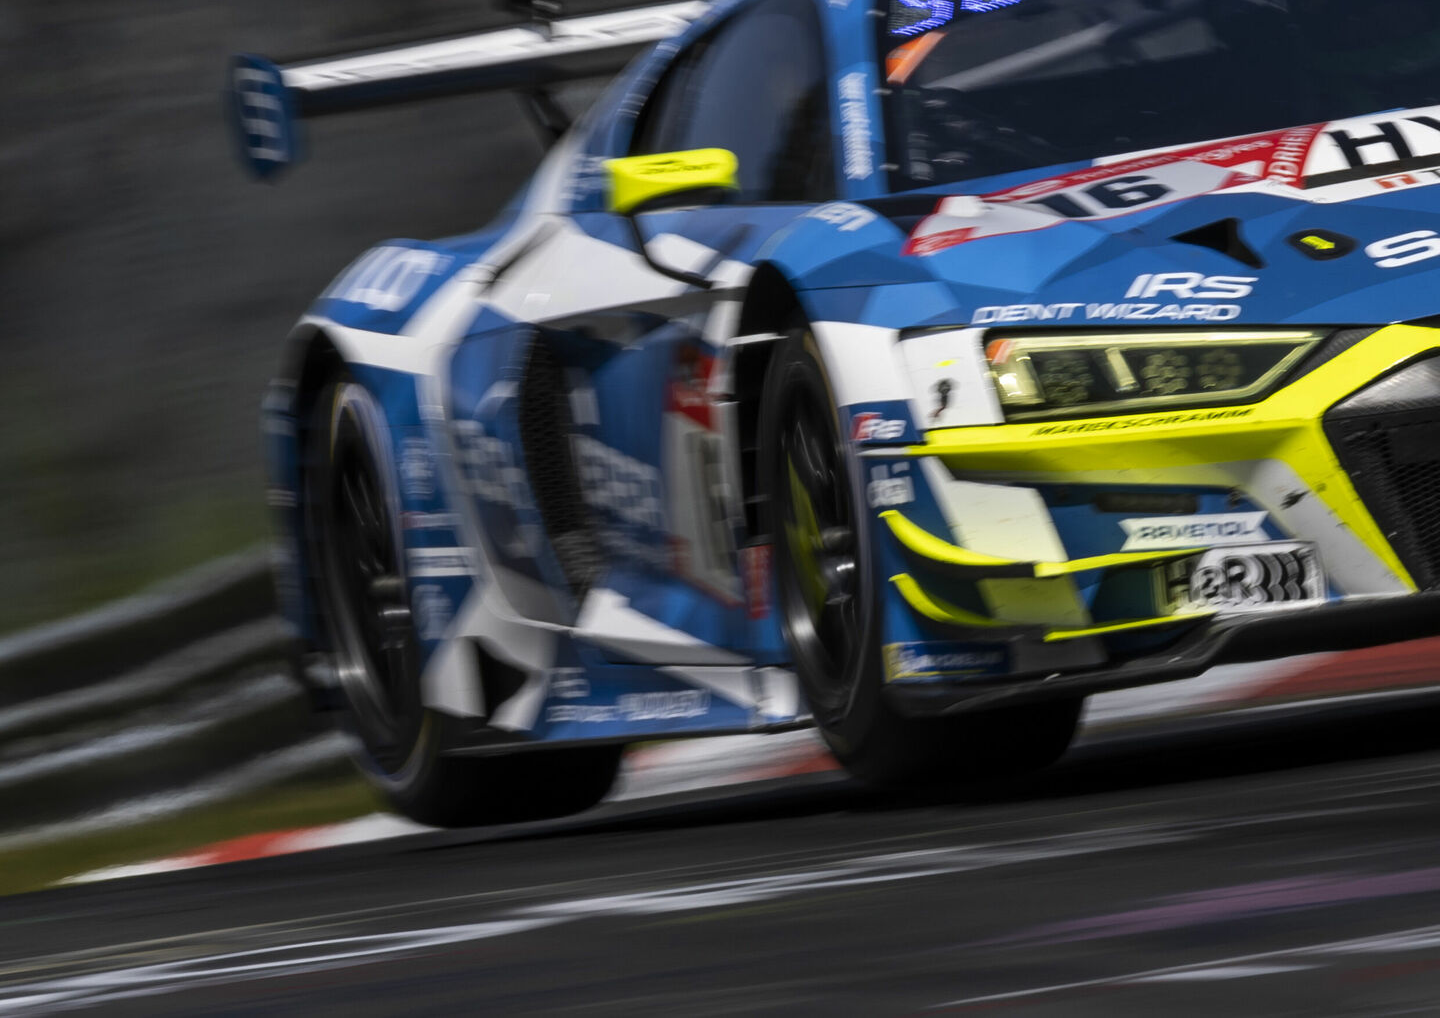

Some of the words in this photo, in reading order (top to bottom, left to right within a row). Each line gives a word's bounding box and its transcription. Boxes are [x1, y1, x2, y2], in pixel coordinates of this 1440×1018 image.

[1028, 175, 1176, 220] 16
[1124, 272, 1259, 299] IRS
[970, 302, 1086, 325] DENT
[1085, 303, 1242, 322] WIZARD
